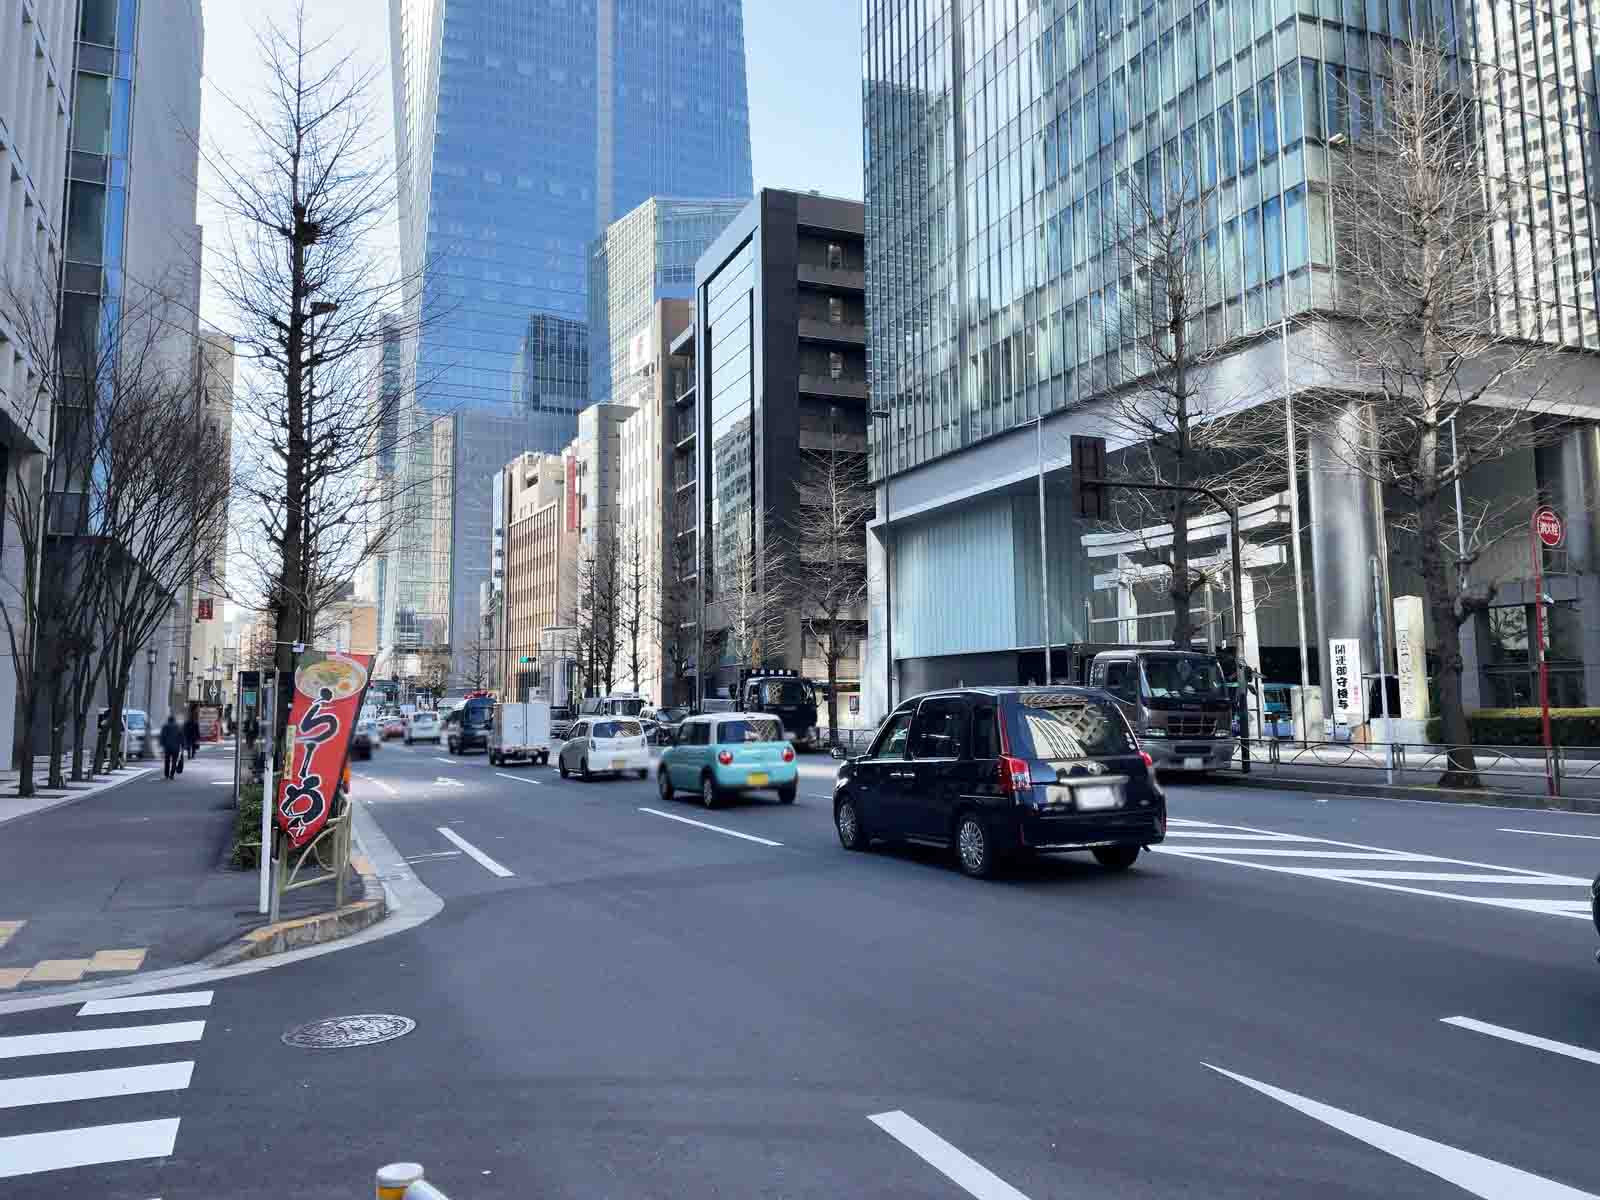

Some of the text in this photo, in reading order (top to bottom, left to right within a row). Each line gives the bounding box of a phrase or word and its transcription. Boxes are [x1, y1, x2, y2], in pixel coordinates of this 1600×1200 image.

[1334, 644, 1349, 710] 開運御守授与
